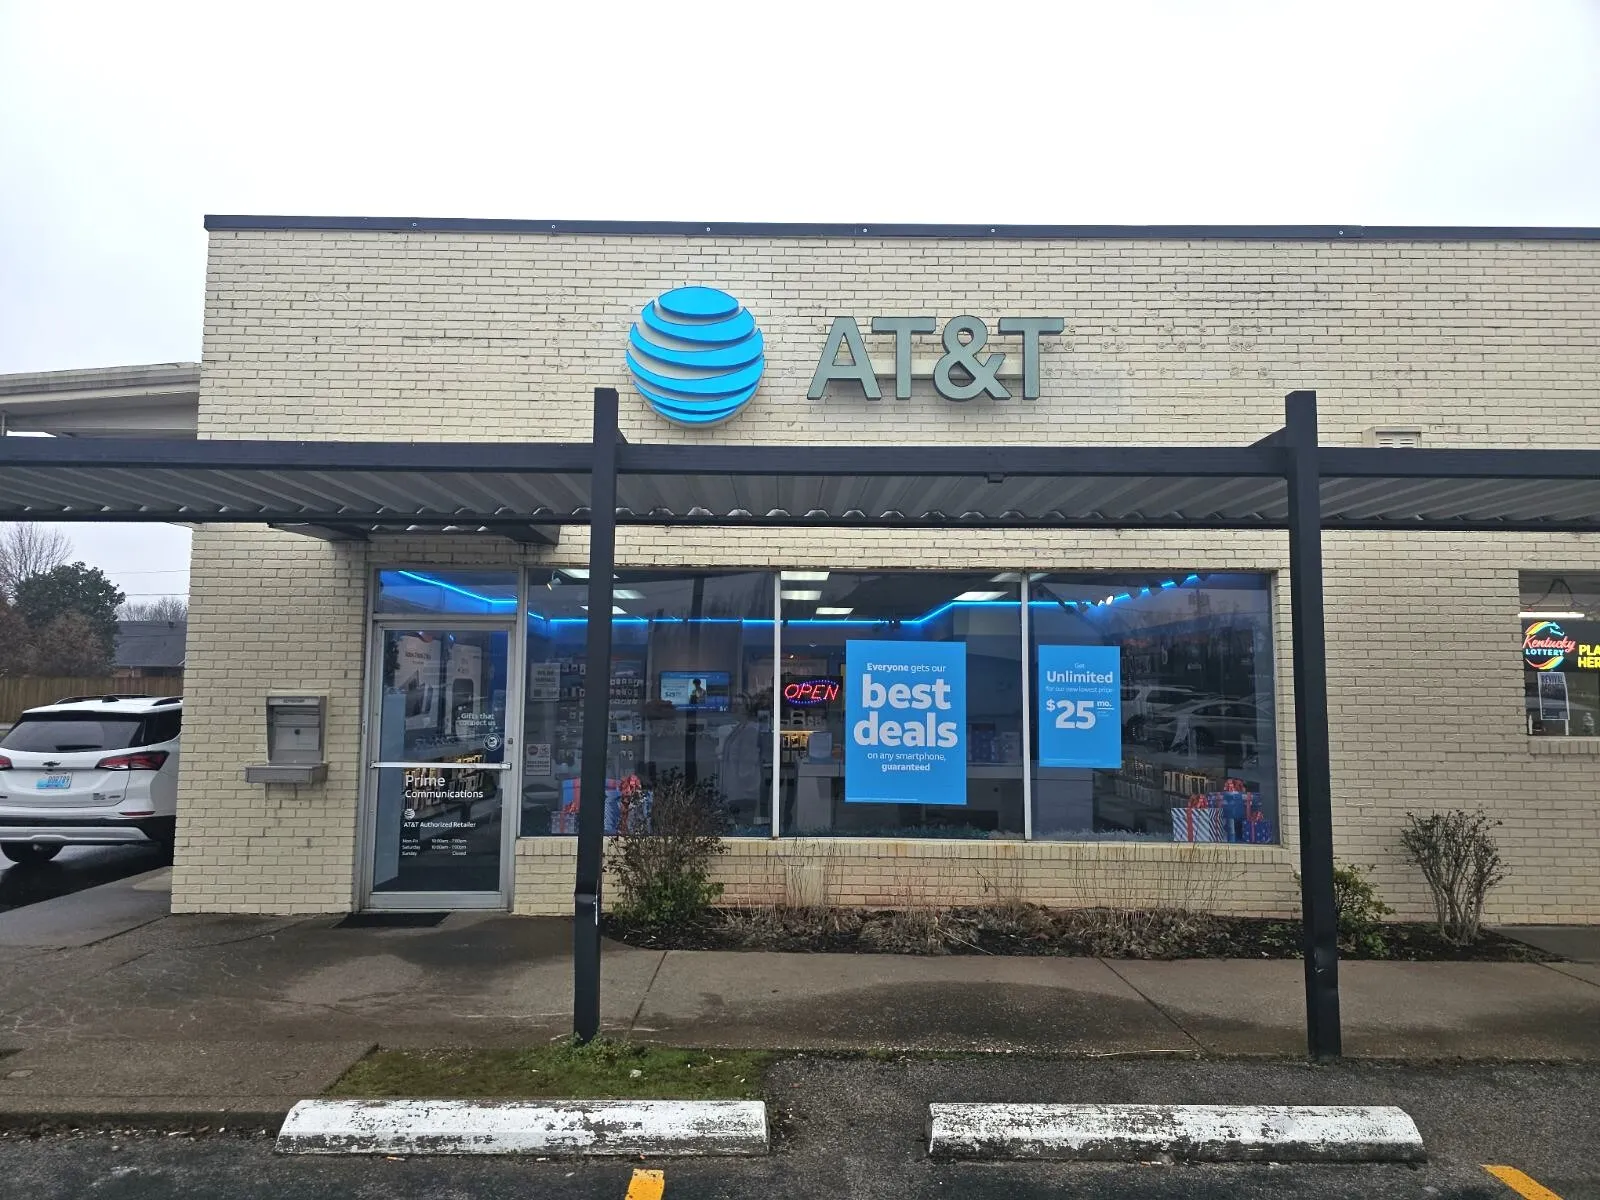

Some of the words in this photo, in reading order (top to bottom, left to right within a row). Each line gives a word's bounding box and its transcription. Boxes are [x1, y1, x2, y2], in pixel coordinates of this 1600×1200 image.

[807, 315, 1064, 401] AT&T
[1523, 633, 1576, 653] Kentucky
[1526, 648, 1564, 656] LOTTERY
[867, 663, 908, 672] Everyone
[911, 665, 930, 673] gets
[1046, 671, 1113, 683] Unlimited
[784, 683, 840, 701] OPEN
[862, 673, 951, 710] best
[1046, 698, 1096, 730] $25
[1097, 700, 1113, 708] mo.
[853, 711, 958, 748] deals
[879, 753, 894, 761] any
[896, 752, 946, 761] smartphone,
[881, 763, 931, 772] guaranteed
[405, 774, 446, 787] Prime
[405, 789, 484, 798] Communications
